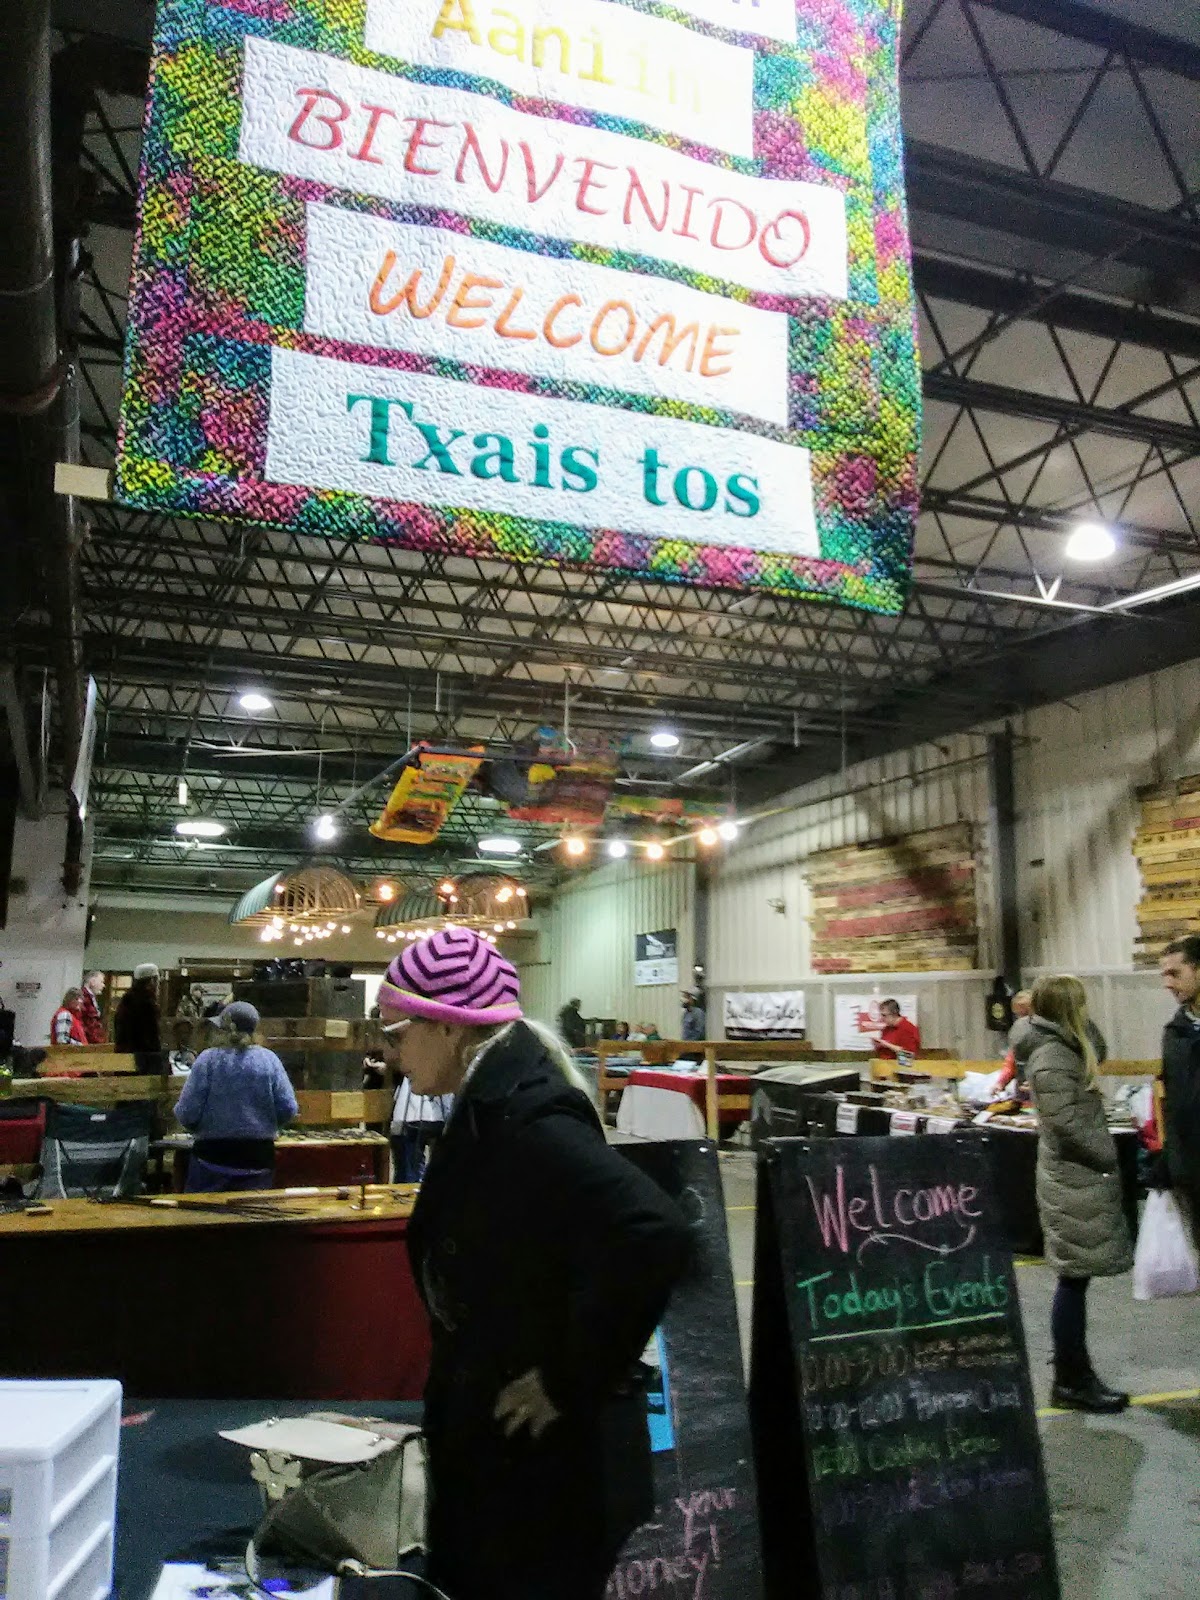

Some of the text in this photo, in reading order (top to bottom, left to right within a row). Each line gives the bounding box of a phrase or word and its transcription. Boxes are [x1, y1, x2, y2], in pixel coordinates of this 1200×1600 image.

[288, 88, 811, 269] BIENVENIDO
[369, 250, 742, 378] WELCOME
[346, 393, 762, 518] Txais tos
[805, 1164, 982, 1252] Welcome
[923, 1255, 1010, 1315] Events
